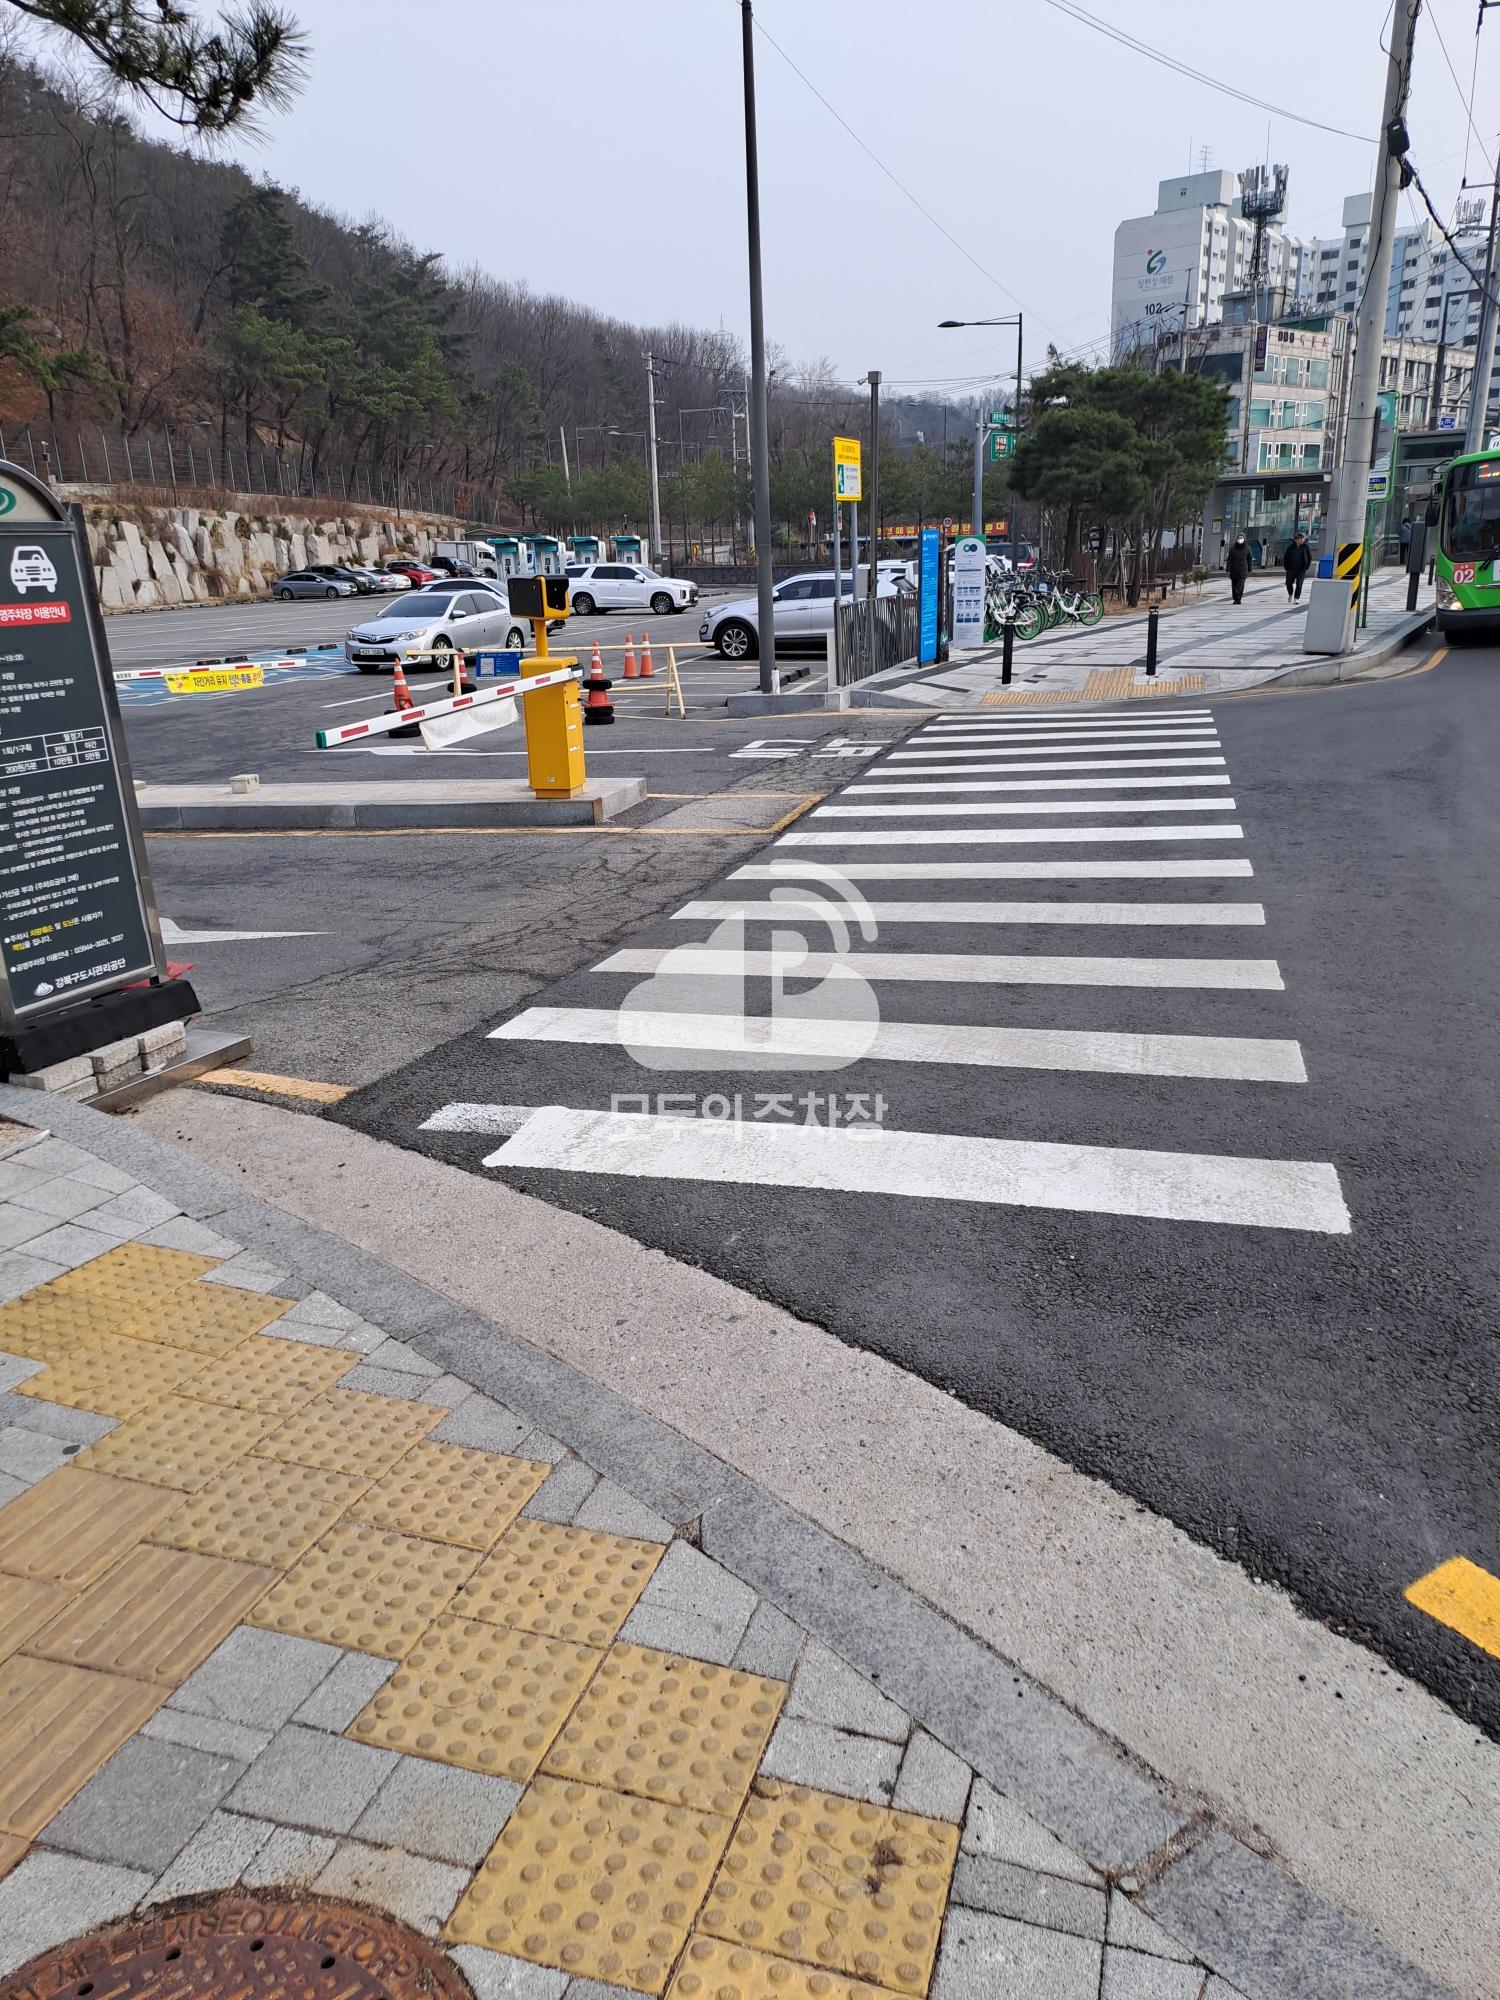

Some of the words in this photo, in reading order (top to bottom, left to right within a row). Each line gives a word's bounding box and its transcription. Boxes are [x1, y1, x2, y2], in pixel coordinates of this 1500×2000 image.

[1145, 303, 1161, 315] 102
[1453, 569, 1475, 583] 02
[33, 605, 67, 619] 이용안내
[53, 755, 73, 766] 10만원
[84, 751, 101, 761] 5만원
[54, 957, 127, 989] 강북구도시관리공단
